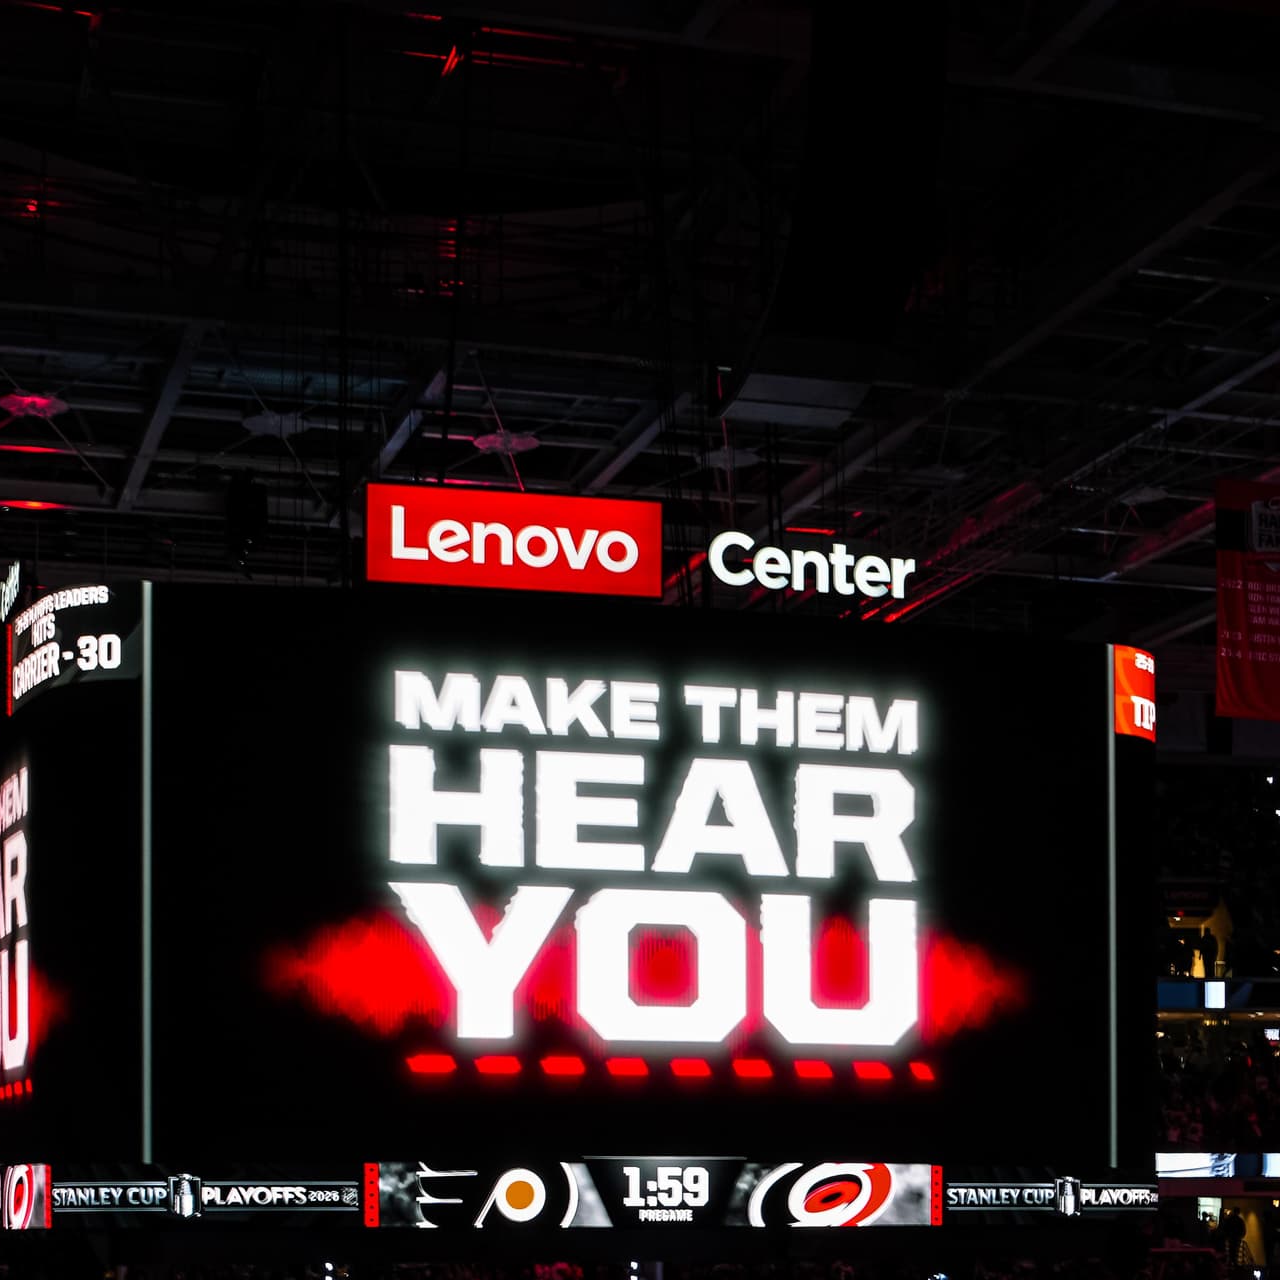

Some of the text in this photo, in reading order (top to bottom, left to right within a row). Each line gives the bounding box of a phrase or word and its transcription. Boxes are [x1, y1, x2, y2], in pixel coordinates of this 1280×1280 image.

[390, 505, 639, 574] Lenovo
[708, 530, 916, 599] Center
[76, 633, 122, 672] 30
[394, 670, 920, 755] MAKE THEM
[388, 744, 918, 883] HEAR
[387, 880, 919, 1047] YOU
[52, 1187, 339, 1207] STANLEY CUP PLAYOFFS 2026
[624, 1167, 710, 1208] 1:59
[947, 1187, 1150, 1205] STANLEY CUP PLAYOFFS
[639, 1209, 693, 1224] PREGAME
